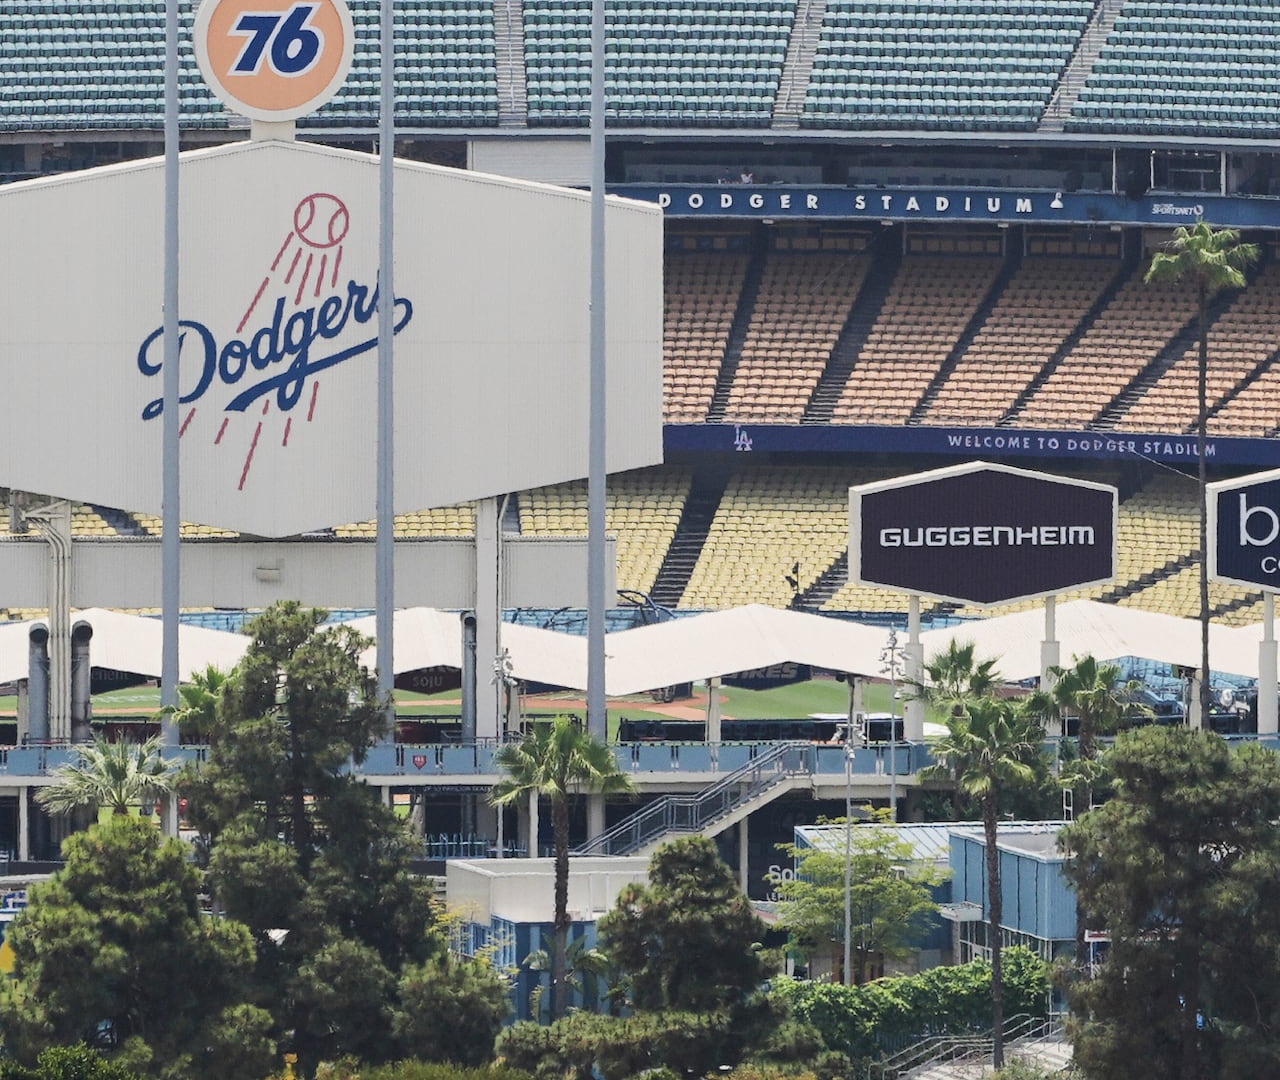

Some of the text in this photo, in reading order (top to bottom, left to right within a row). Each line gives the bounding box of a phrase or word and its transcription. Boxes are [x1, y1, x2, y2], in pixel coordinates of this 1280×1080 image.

[231, 4, 321, 75] 76
[658, 193, 1032, 213] DODGER STADIUM
[733, 423, 753, 451] LA
[948, 434, 1031, 450] WELCOME
[1037, 436, 1060, 450] TO
[1067, 438, 1136, 453] DODGER
[879, 526, 1095, 547] GUGGENHEIM
